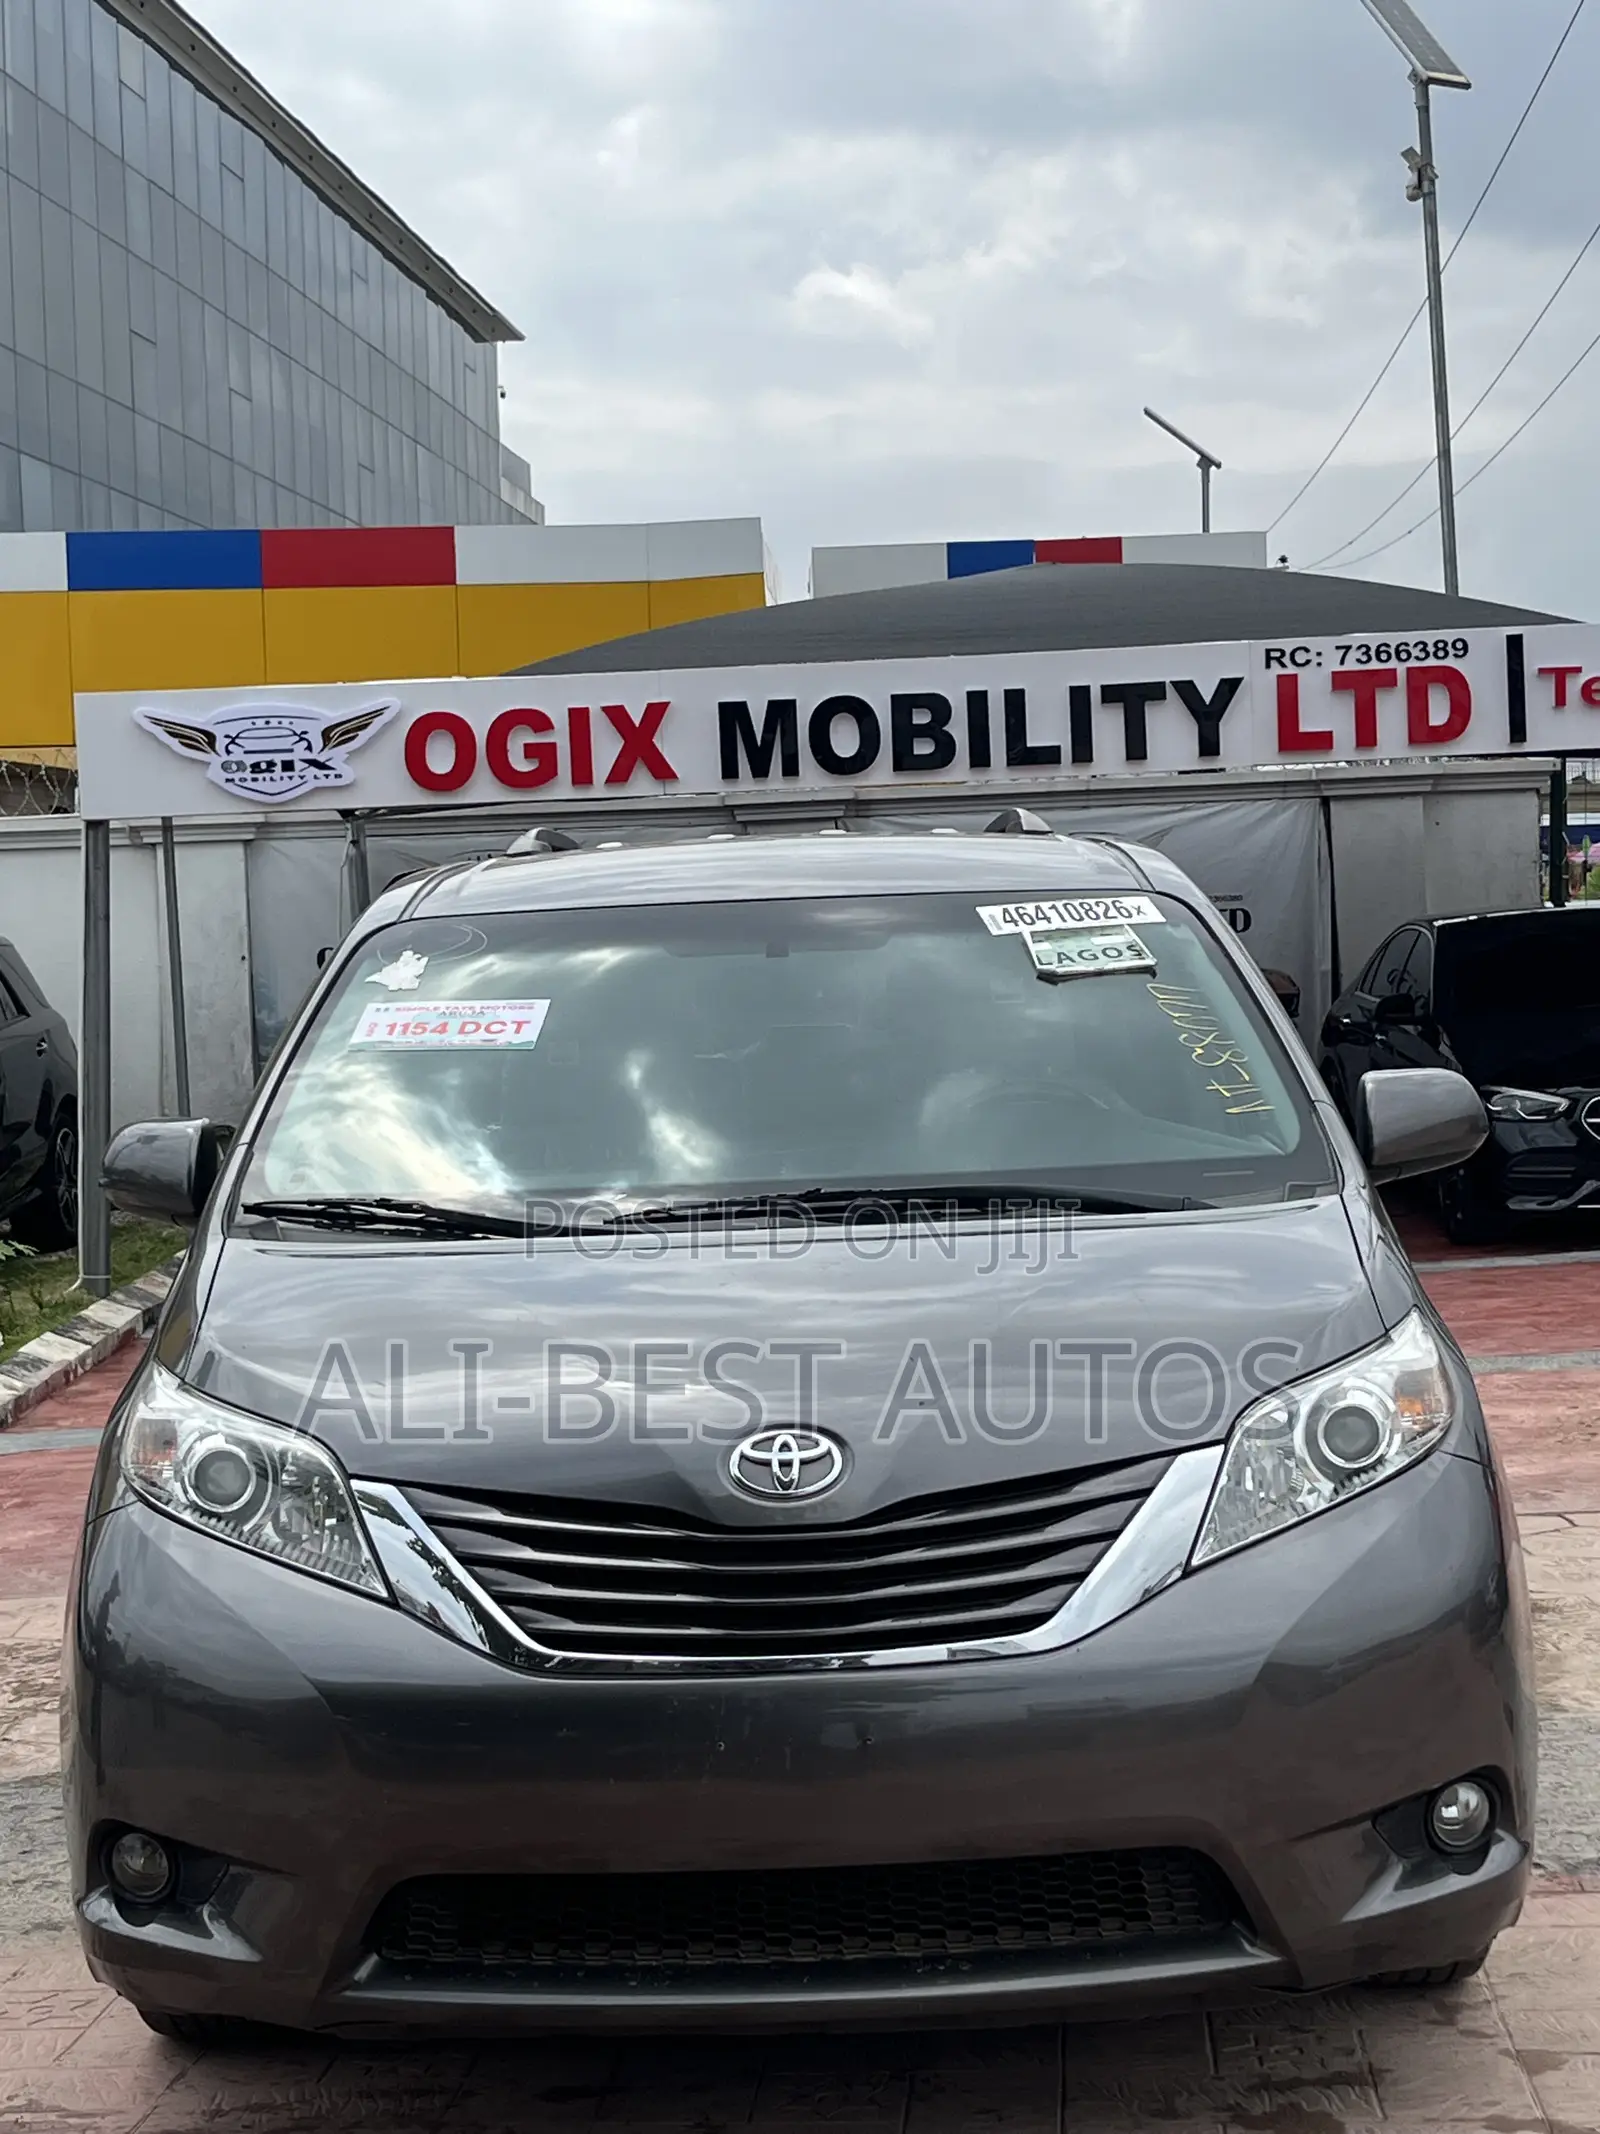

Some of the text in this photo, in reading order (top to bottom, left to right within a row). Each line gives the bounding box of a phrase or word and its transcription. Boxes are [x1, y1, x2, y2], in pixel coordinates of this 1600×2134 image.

[1264, 637, 1469, 669] RC: 7366389
[404, 665, 1473, 792] OGIX MOBILITY LTD
[225, 774, 306, 783] MOBILITY
[1036, 944, 1143, 966] LAGOS
[386, 1021, 449, 1036] 1154
[457, 1020, 532, 1035] DCT
